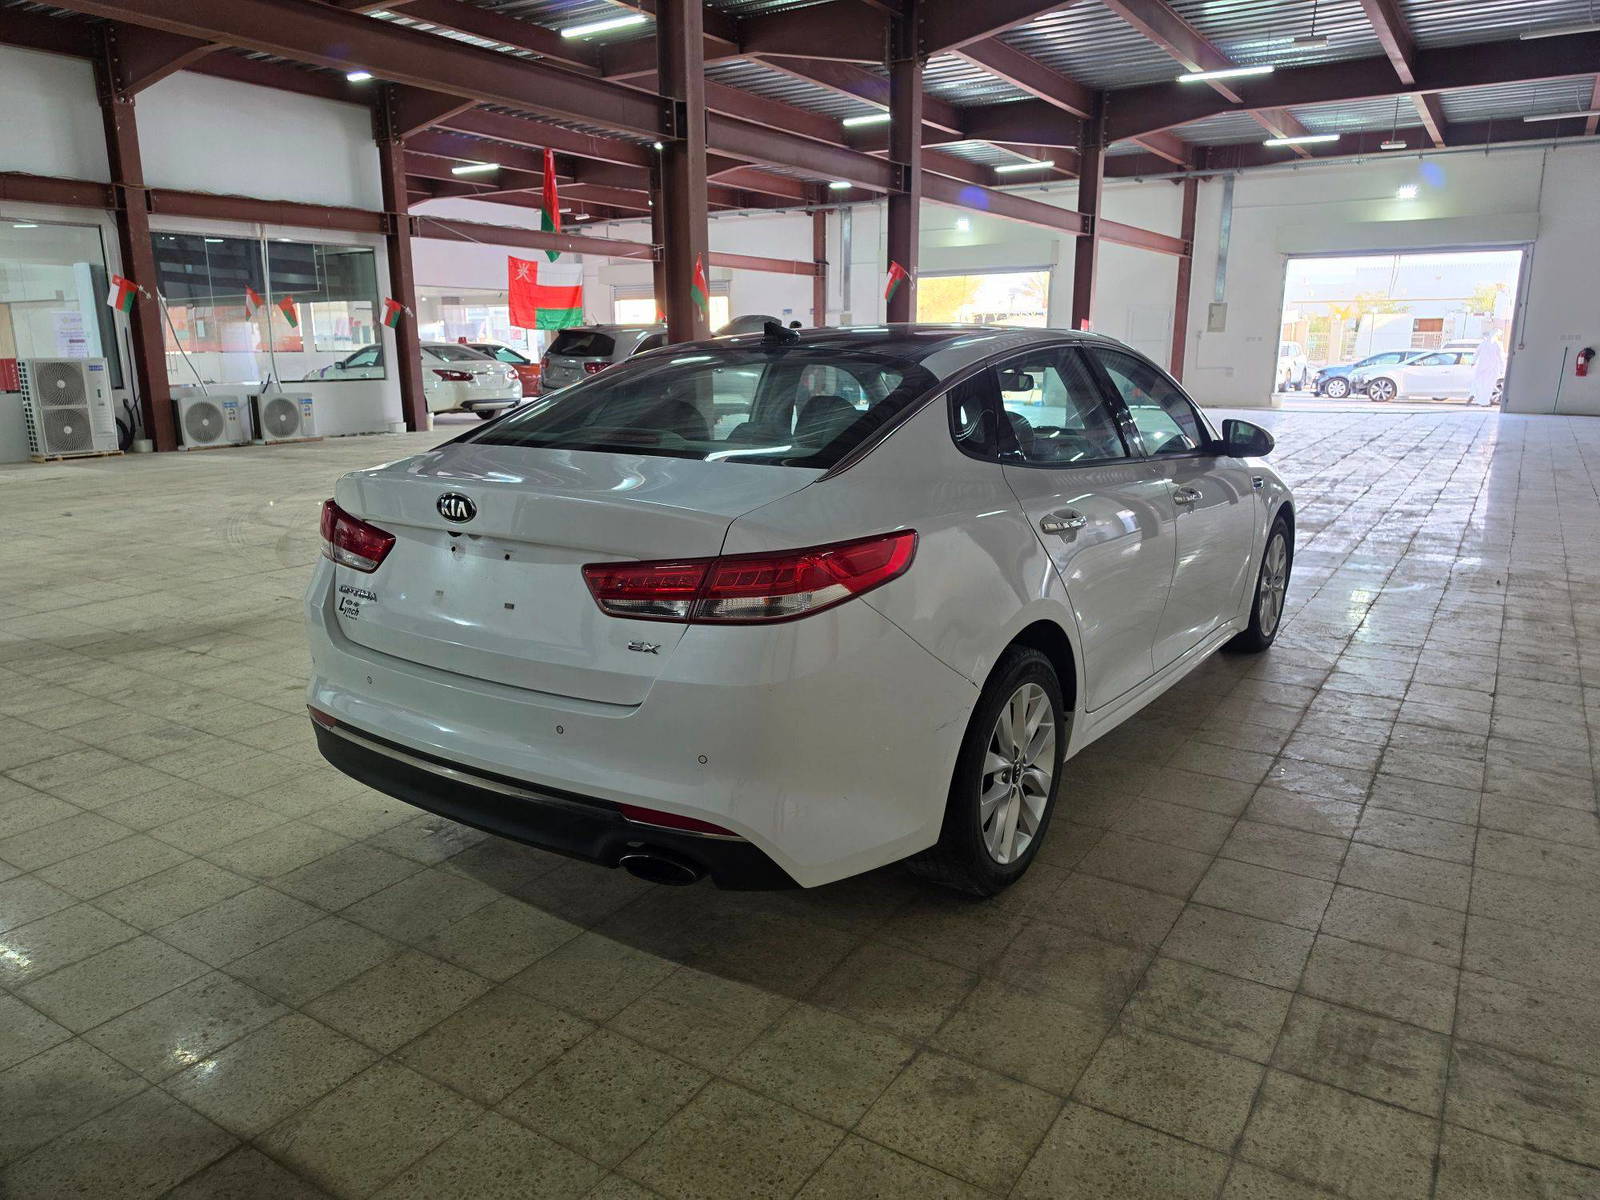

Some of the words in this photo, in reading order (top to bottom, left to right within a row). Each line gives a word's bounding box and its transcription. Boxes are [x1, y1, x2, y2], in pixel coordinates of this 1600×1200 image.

[441, 499, 468, 518] KIA
[339, 597, 360, 616] Lynch
[628, 641, 661, 655] EX
